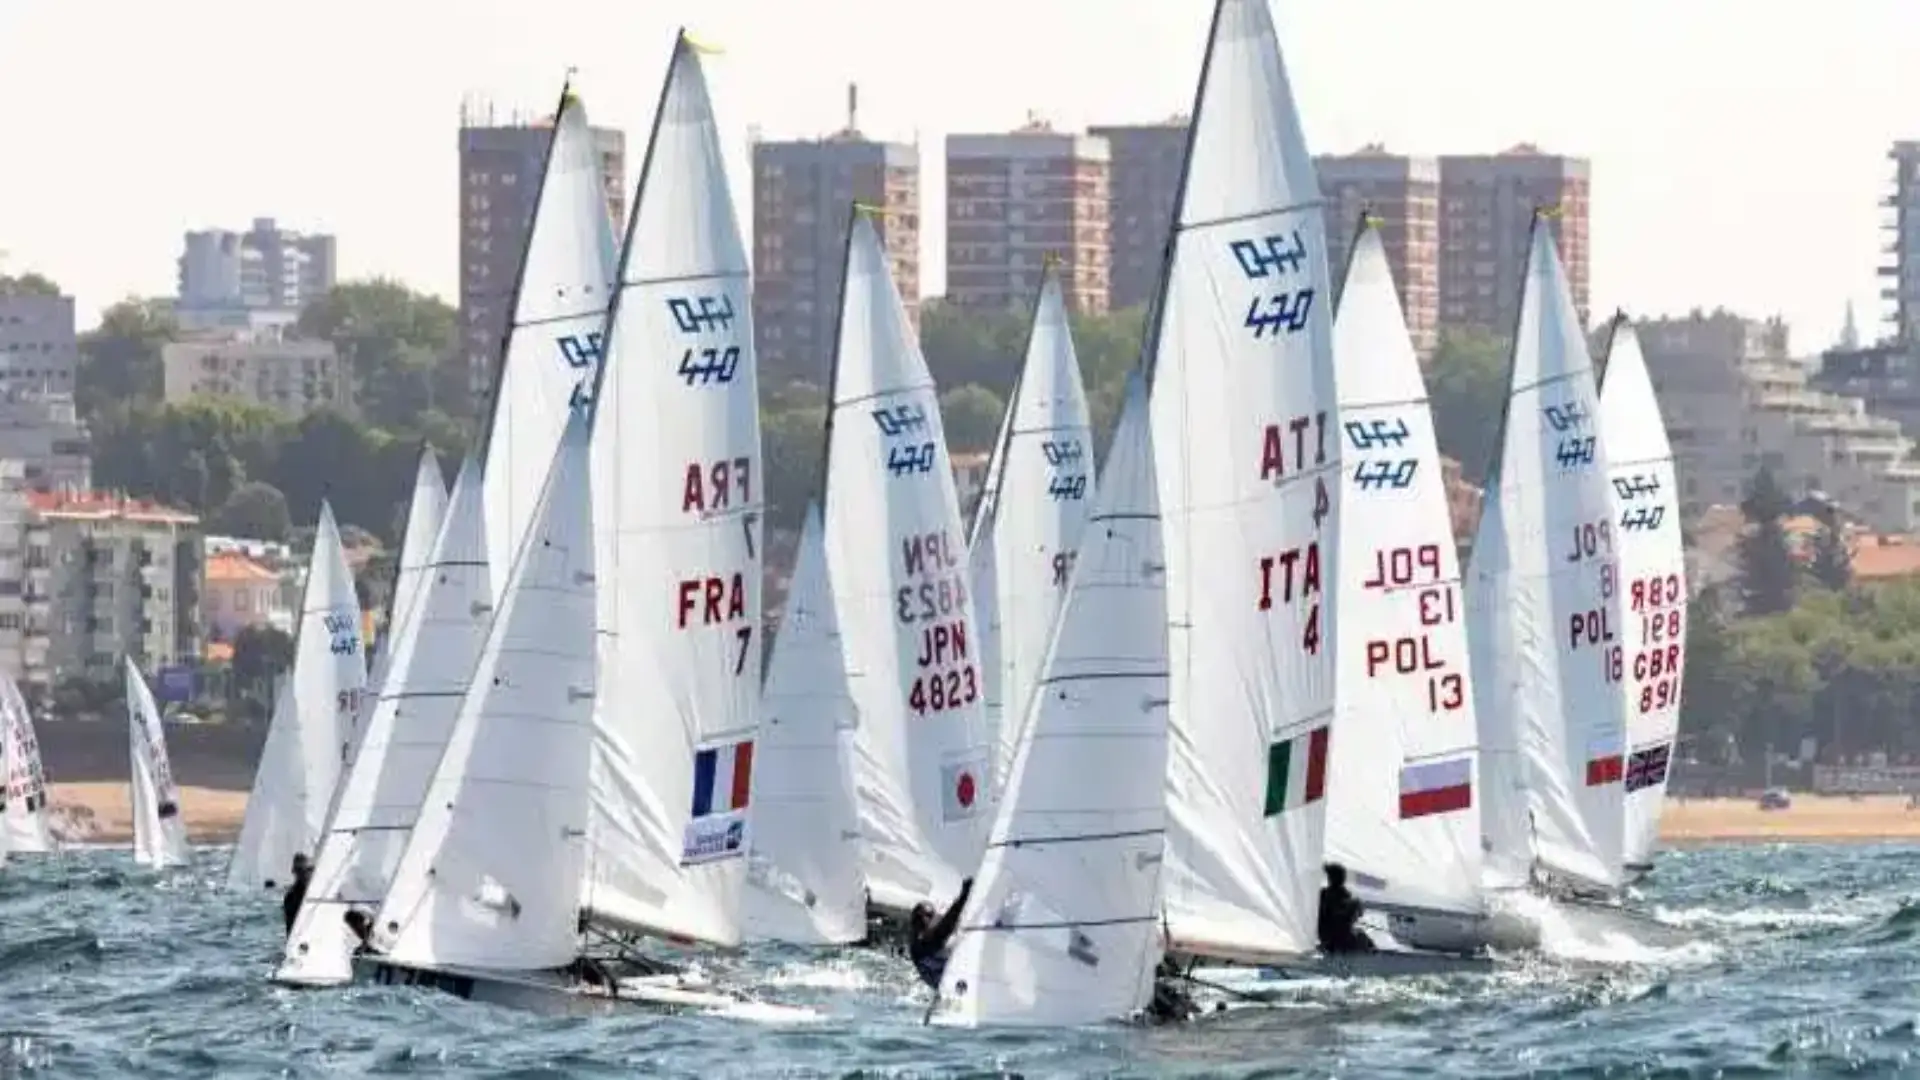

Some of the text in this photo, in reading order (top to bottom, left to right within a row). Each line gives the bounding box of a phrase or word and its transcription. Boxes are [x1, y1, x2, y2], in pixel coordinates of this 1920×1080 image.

[1244, 288, 1314, 338] 470
[677, 346, 740, 386] 470
[888, 442, 935, 478] 470
[1556, 436, 1596, 467] 470
[1048, 476, 1087, 501] 470
[1353, 459, 1419, 490] 470
[1620, 506, 1666, 532] 470
[1258, 542, 1321, 611] ITA
[679, 573, 744, 629] FRA
[918, 620, 966, 668] JPN
[1303, 604, 1319, 655] 4
[1570, 607, 1613, 649] POL
[735, 627, 752, 676] 7
[1367, 635, 1445, 678] POL
[1605, 646, 1623, 682] 18
[1633, 643, 1679, 682] GBR
[909, 665, 978, 715] 4823
[1429, 673, 1464, 713] 13
[1640, 677, 1677, 713] 891
